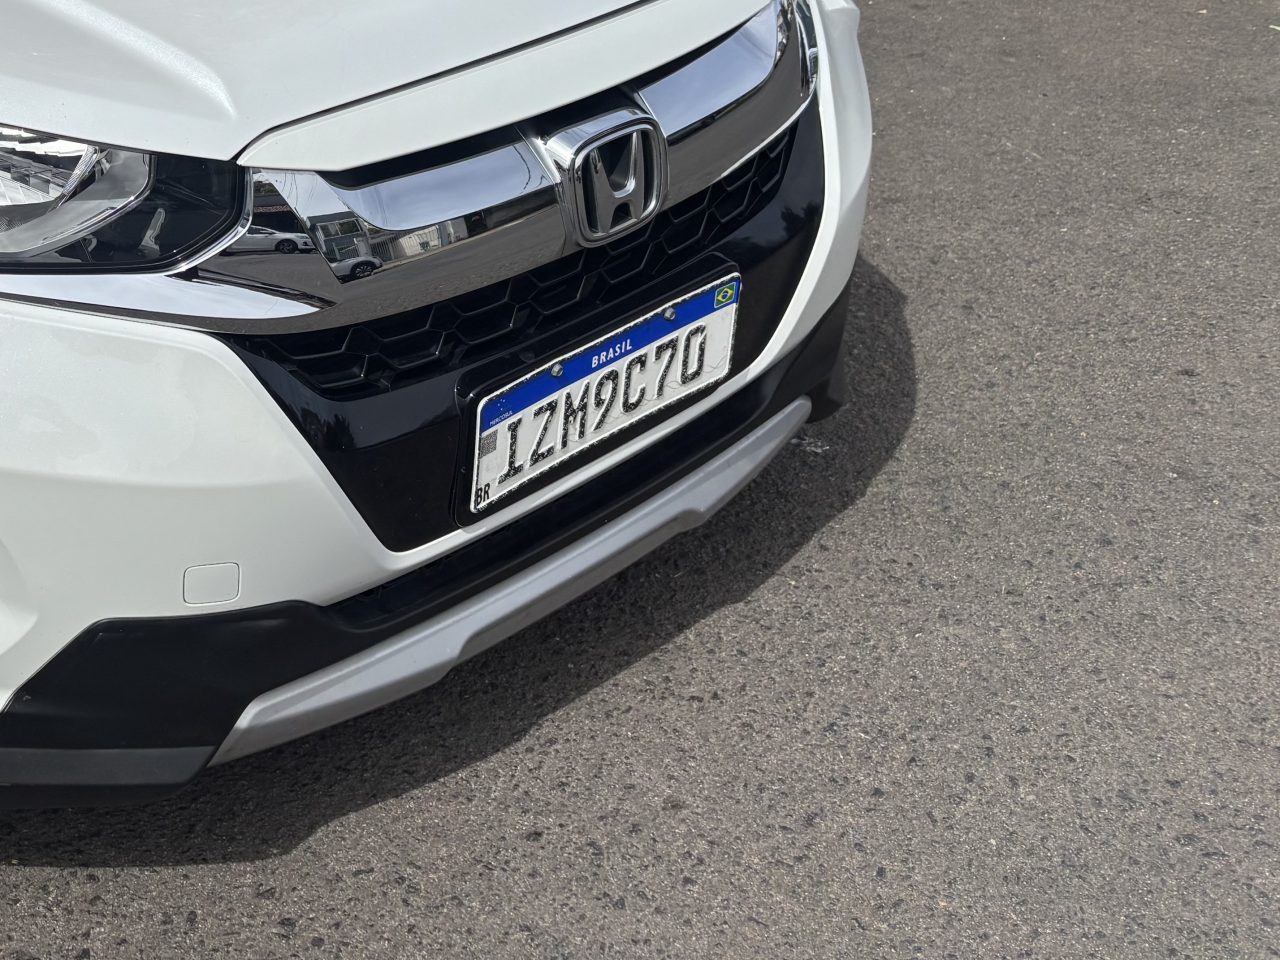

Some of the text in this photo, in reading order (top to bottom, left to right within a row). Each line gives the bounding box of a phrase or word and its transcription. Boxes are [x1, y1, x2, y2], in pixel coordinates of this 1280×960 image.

[591, 338, 633, 369] BRASIL
[496, 323, 707, 486] IZM9C70
[475, 482, 491, 507] BR
